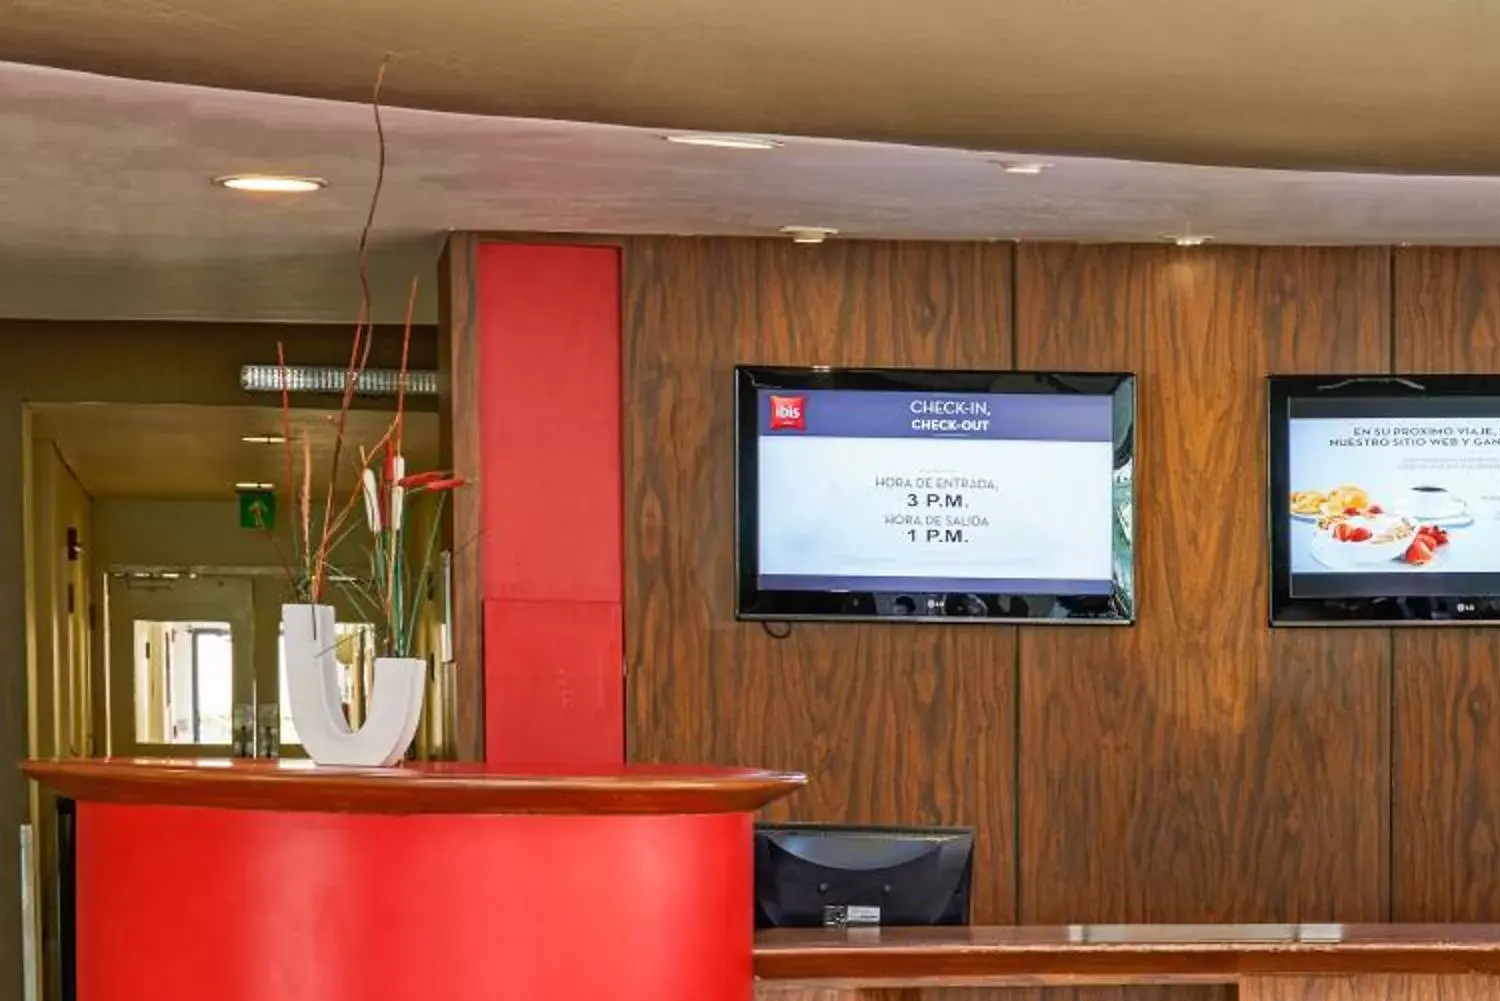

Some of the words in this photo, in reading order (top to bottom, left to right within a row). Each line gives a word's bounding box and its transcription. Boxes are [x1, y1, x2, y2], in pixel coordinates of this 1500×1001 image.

[776, 403, 801, 419] ibis
[909, 399, 991, 417] CHECK-IN,
[911, 419, 990, 431] CHECK-OUT
[1329, 437, 1389, 447] NUESTRO
[1429, 437, 1458, 447] WEB
[874, 476, 912, 489] HORA
[915, 477, 933, 489] DE
[906, 493, 919, 507] 3
[926, 493, 969, 509] P.M.
[884, 513, 922, 526] HORA
[925, 514, 943, 526] DE
[946, 514, 990, 527] SALIDA
[907, 529, 917, 542] 1
[926, 529, 969, 543] P.M.
